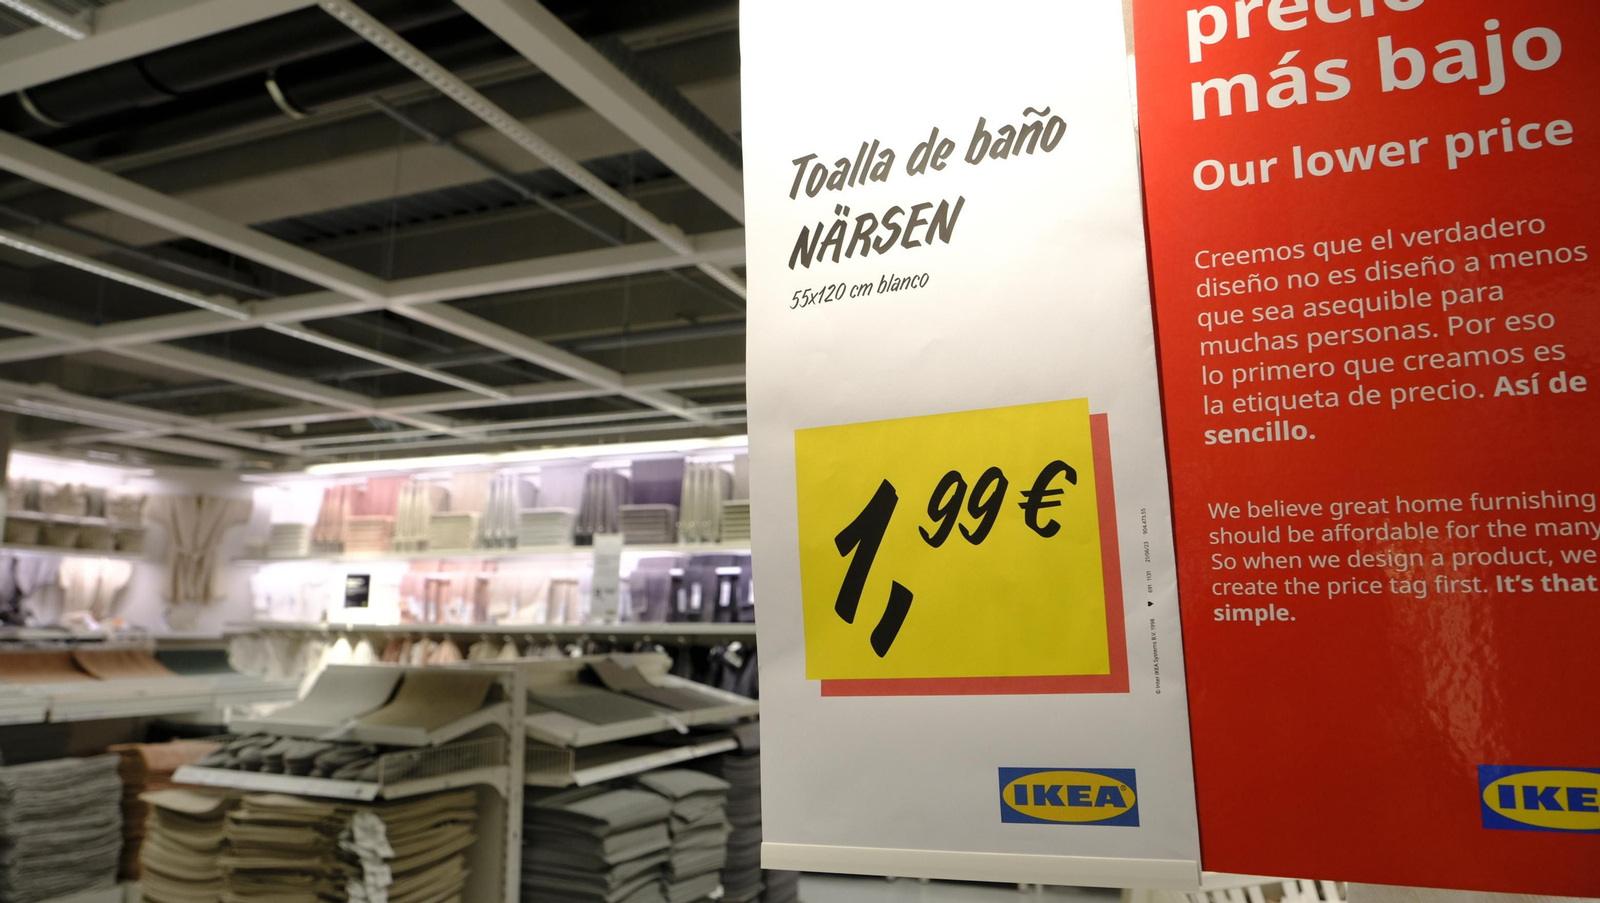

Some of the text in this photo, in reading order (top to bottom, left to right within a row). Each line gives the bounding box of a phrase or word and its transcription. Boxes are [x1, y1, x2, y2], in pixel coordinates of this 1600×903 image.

[1186, 0, 1424, 63] prec
[1191, 19, 1562, 121] más bajo
[788, 105, 1067, 200] Toalla de baño
[1193, 117, 1573, 191] Our lower price
[788, 195, 966, 270] NÄRSEN
[1195, 218, 1545, 269] Creemos que el verdadero
[790, 272, 930, 310] 55x120 cm blanco
[1197, 246, 1588, 298] diseño no es diseño a menos
[1198, 285, 1503, 332] que sea asequible para
[1201, 313, 1555, 356] muchas personas. Por eso
[1202, 344, 1565, 389] lo primero que creamos es
[1204, 371, 1587, 416] la etiqueta de precio. Así de
[1204, 420, 1315, 445] sencillo.
[1018, 459, 1078, 538] €
[1208, 490, 1596, 520] We believe great home furnishing
[1209, 519, 1600, 544] should be affordable for the many
[1212, 546, 1597, 574] So when we design a product, we
[1212, 573, 1598, 599] create the price tag first. It’s that
[1214, 603, 1296, 626] simple.
